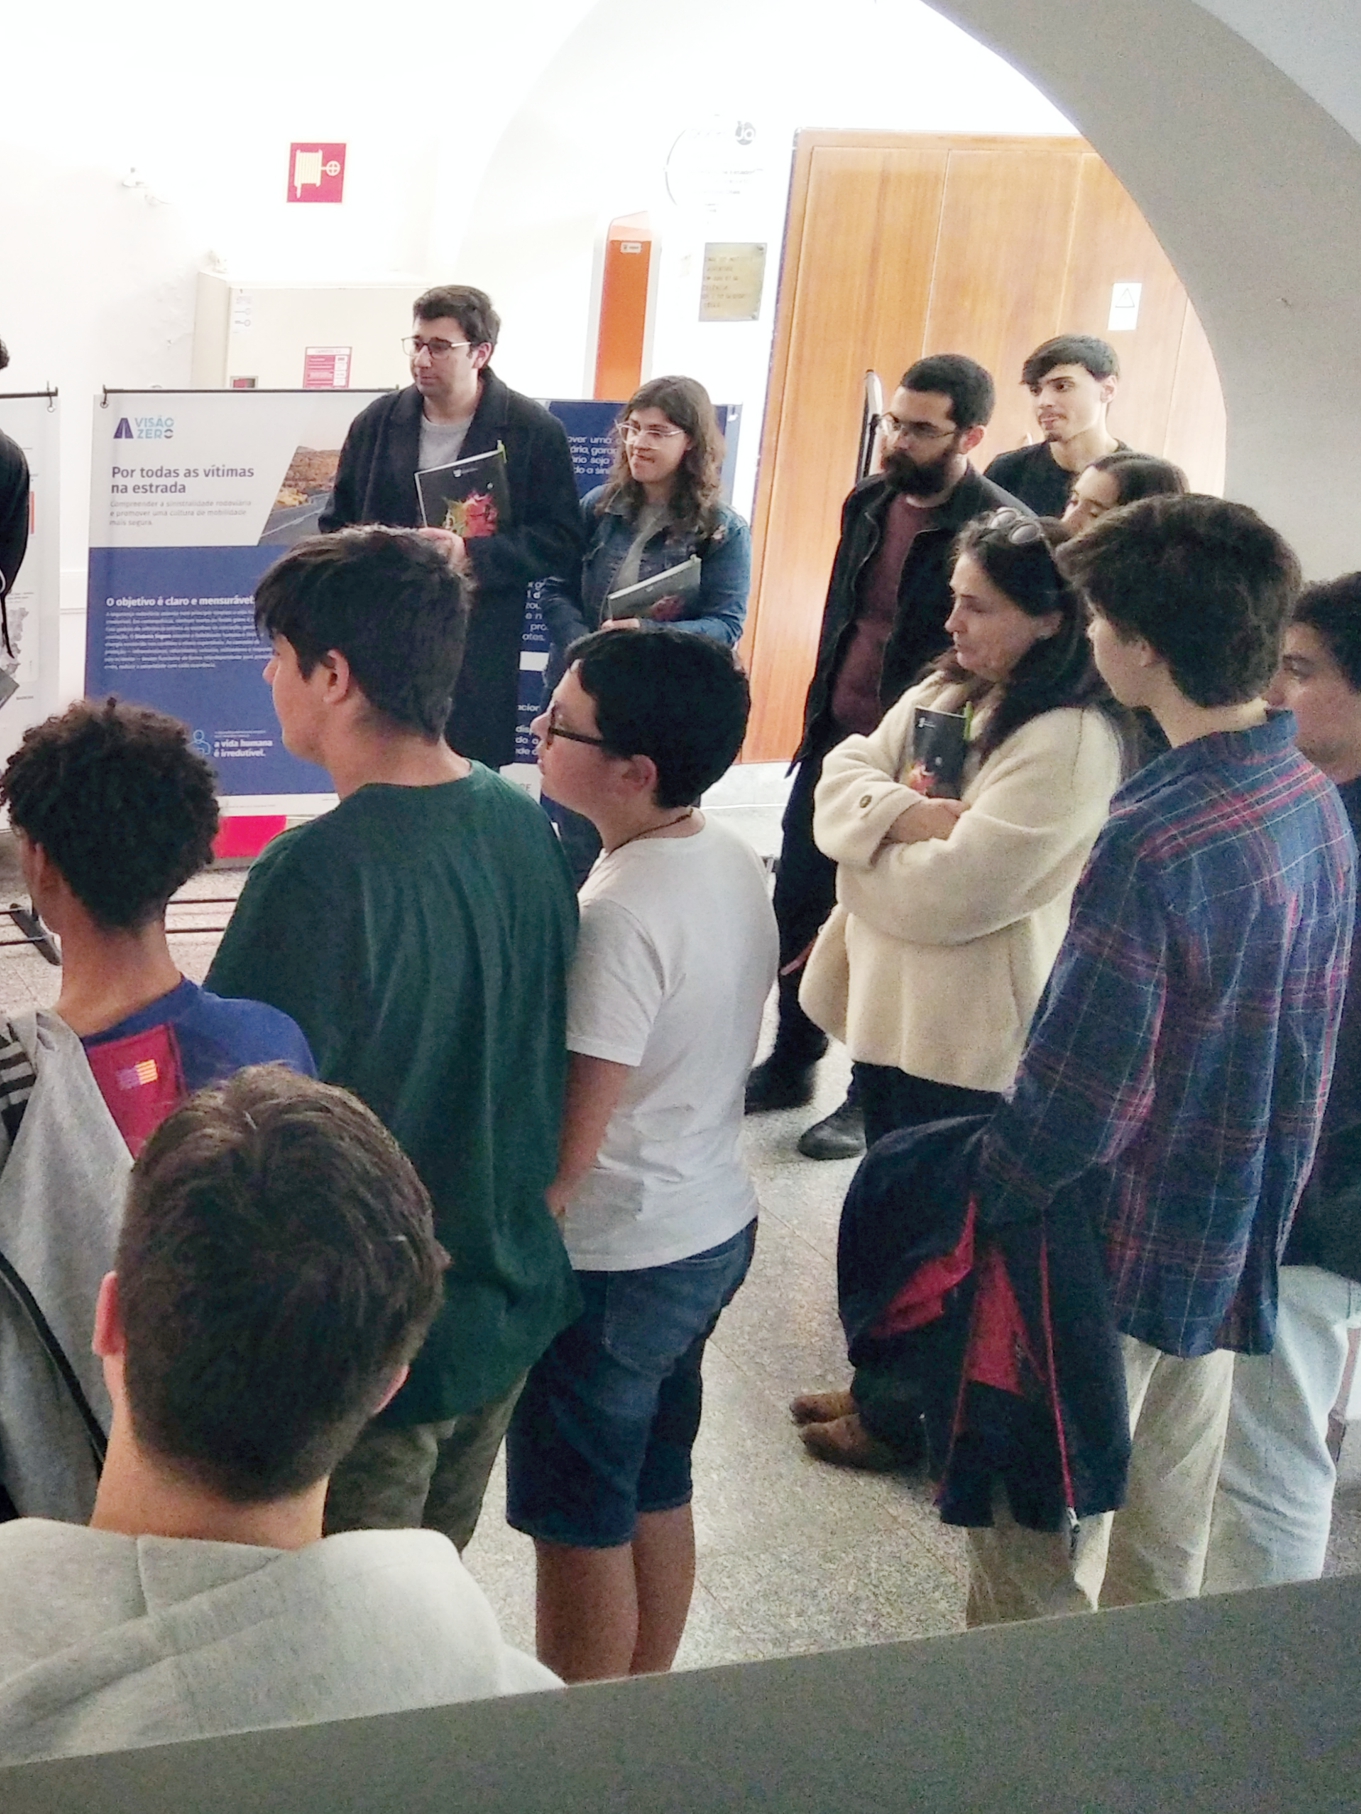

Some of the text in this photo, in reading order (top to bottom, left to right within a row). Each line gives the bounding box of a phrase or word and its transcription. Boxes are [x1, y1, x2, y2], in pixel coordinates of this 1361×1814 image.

[135, 415, 174, 428] VISÃO
[111, 464, 255, 478] Por todas as vítimas
[111, 481, 187, 494] na estrada
[106, 597, 115, 607] O
[116, 596, 156, 608] objetivo
[157, 596, 163, 606] é
[165, 596, 190, 606] claro
[192, 598, 197, 606] e
